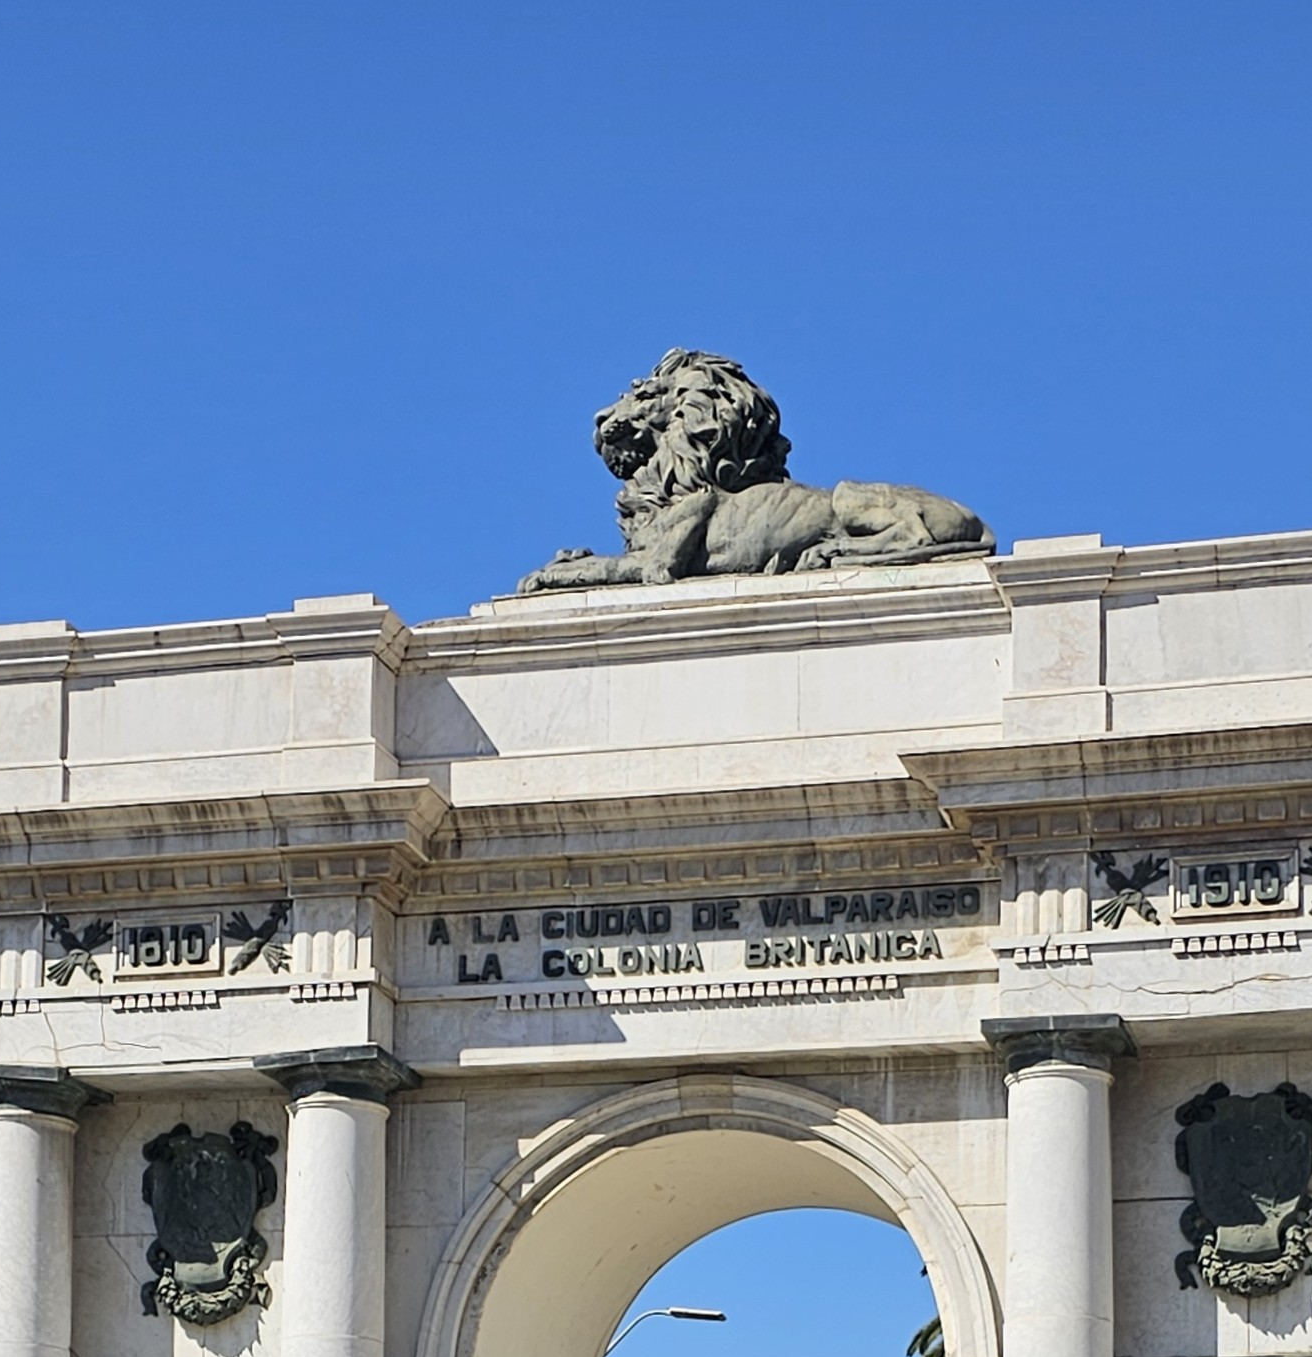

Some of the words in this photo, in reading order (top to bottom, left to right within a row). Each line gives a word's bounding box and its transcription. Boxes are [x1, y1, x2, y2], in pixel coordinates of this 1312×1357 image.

[1188, 862, 1281, 907] 1910
[428, 917, 450, 946] A
[472, 914, 519, 944] LA
[542, 906, 671, 940] CIUDAD
[692, 900, 739, 931] DE
[758, 887, 981, 928] VALPARAISO
[128, 926, 206, 966] 1810
[458, 953, 503, 983] LA
[542, 943, 704, 978] COLONIA
[745, 929, 943, 969] BRITANICA
